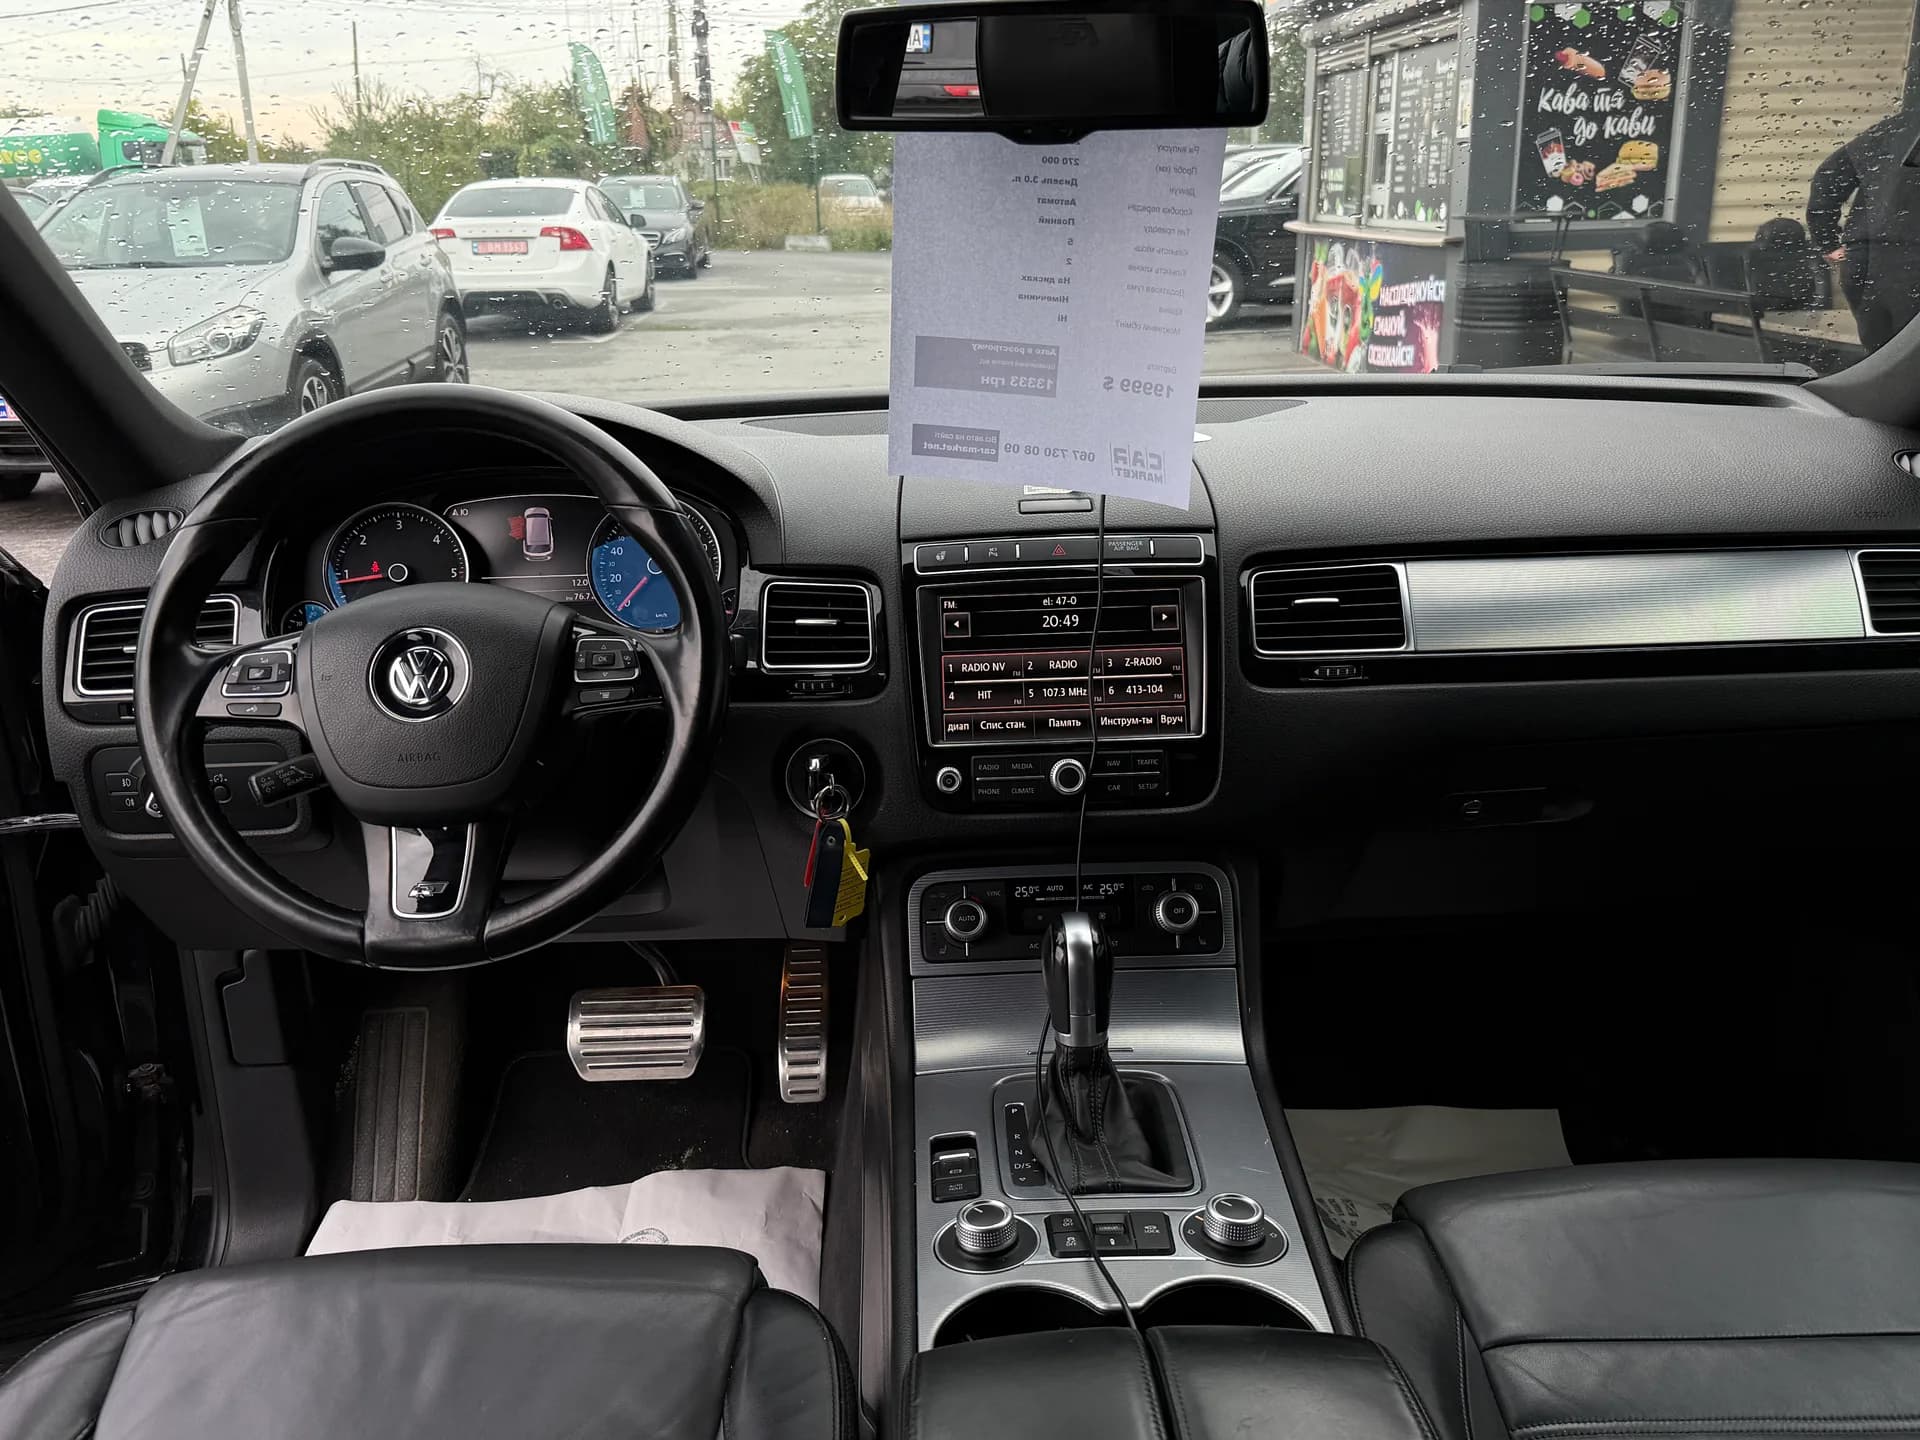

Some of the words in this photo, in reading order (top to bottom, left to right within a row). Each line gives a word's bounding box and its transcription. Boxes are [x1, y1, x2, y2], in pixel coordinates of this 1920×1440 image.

[1538, 82, 1588, 114] Кава
[1593, 88, 1624, 112] та
[1573, 116, 1598, 146] до
[1602, 106, 1656, 139] кави
[610, 546, 624, 556] 40
[609, 573, 622, 583] 20
[1055, 596, 1077, 605] 47-0
[1042, 615, 1079, 628] 20:49
[1027, 661, 1033, 670] 2
[1049, 660, 1077, 670] RADIO
[1107, 658, 1112, 667] 3
[1125, 657, 1162, 667] Z-RADIO
[948, 664, 953, 673] 1
[961, 662, 990, 673] RADIO
[992, 662, 1006, 672] NV
[1028, 688, 1034, 698] 5
[1042, 688, 1066, 697] 107.3
[1068, 688, 1088, 697] MHz
[1108, 686, 1114, 695] 6
[1125, 684, 1163, 695] 413-104
[948, 692, 955, 701] 4
[977, 690, 992, 700] HIT
[1005, 720, 1026, 729] стан.
[1048, 718, 1082, 728] Память
[1100, 716, 1153, 727] Инструм-ты
[1160, 714, 1183, 725] Вруч
[947, 722, 970, 732] диап
[1137, 758, 1159, 766] TRAFFIC
